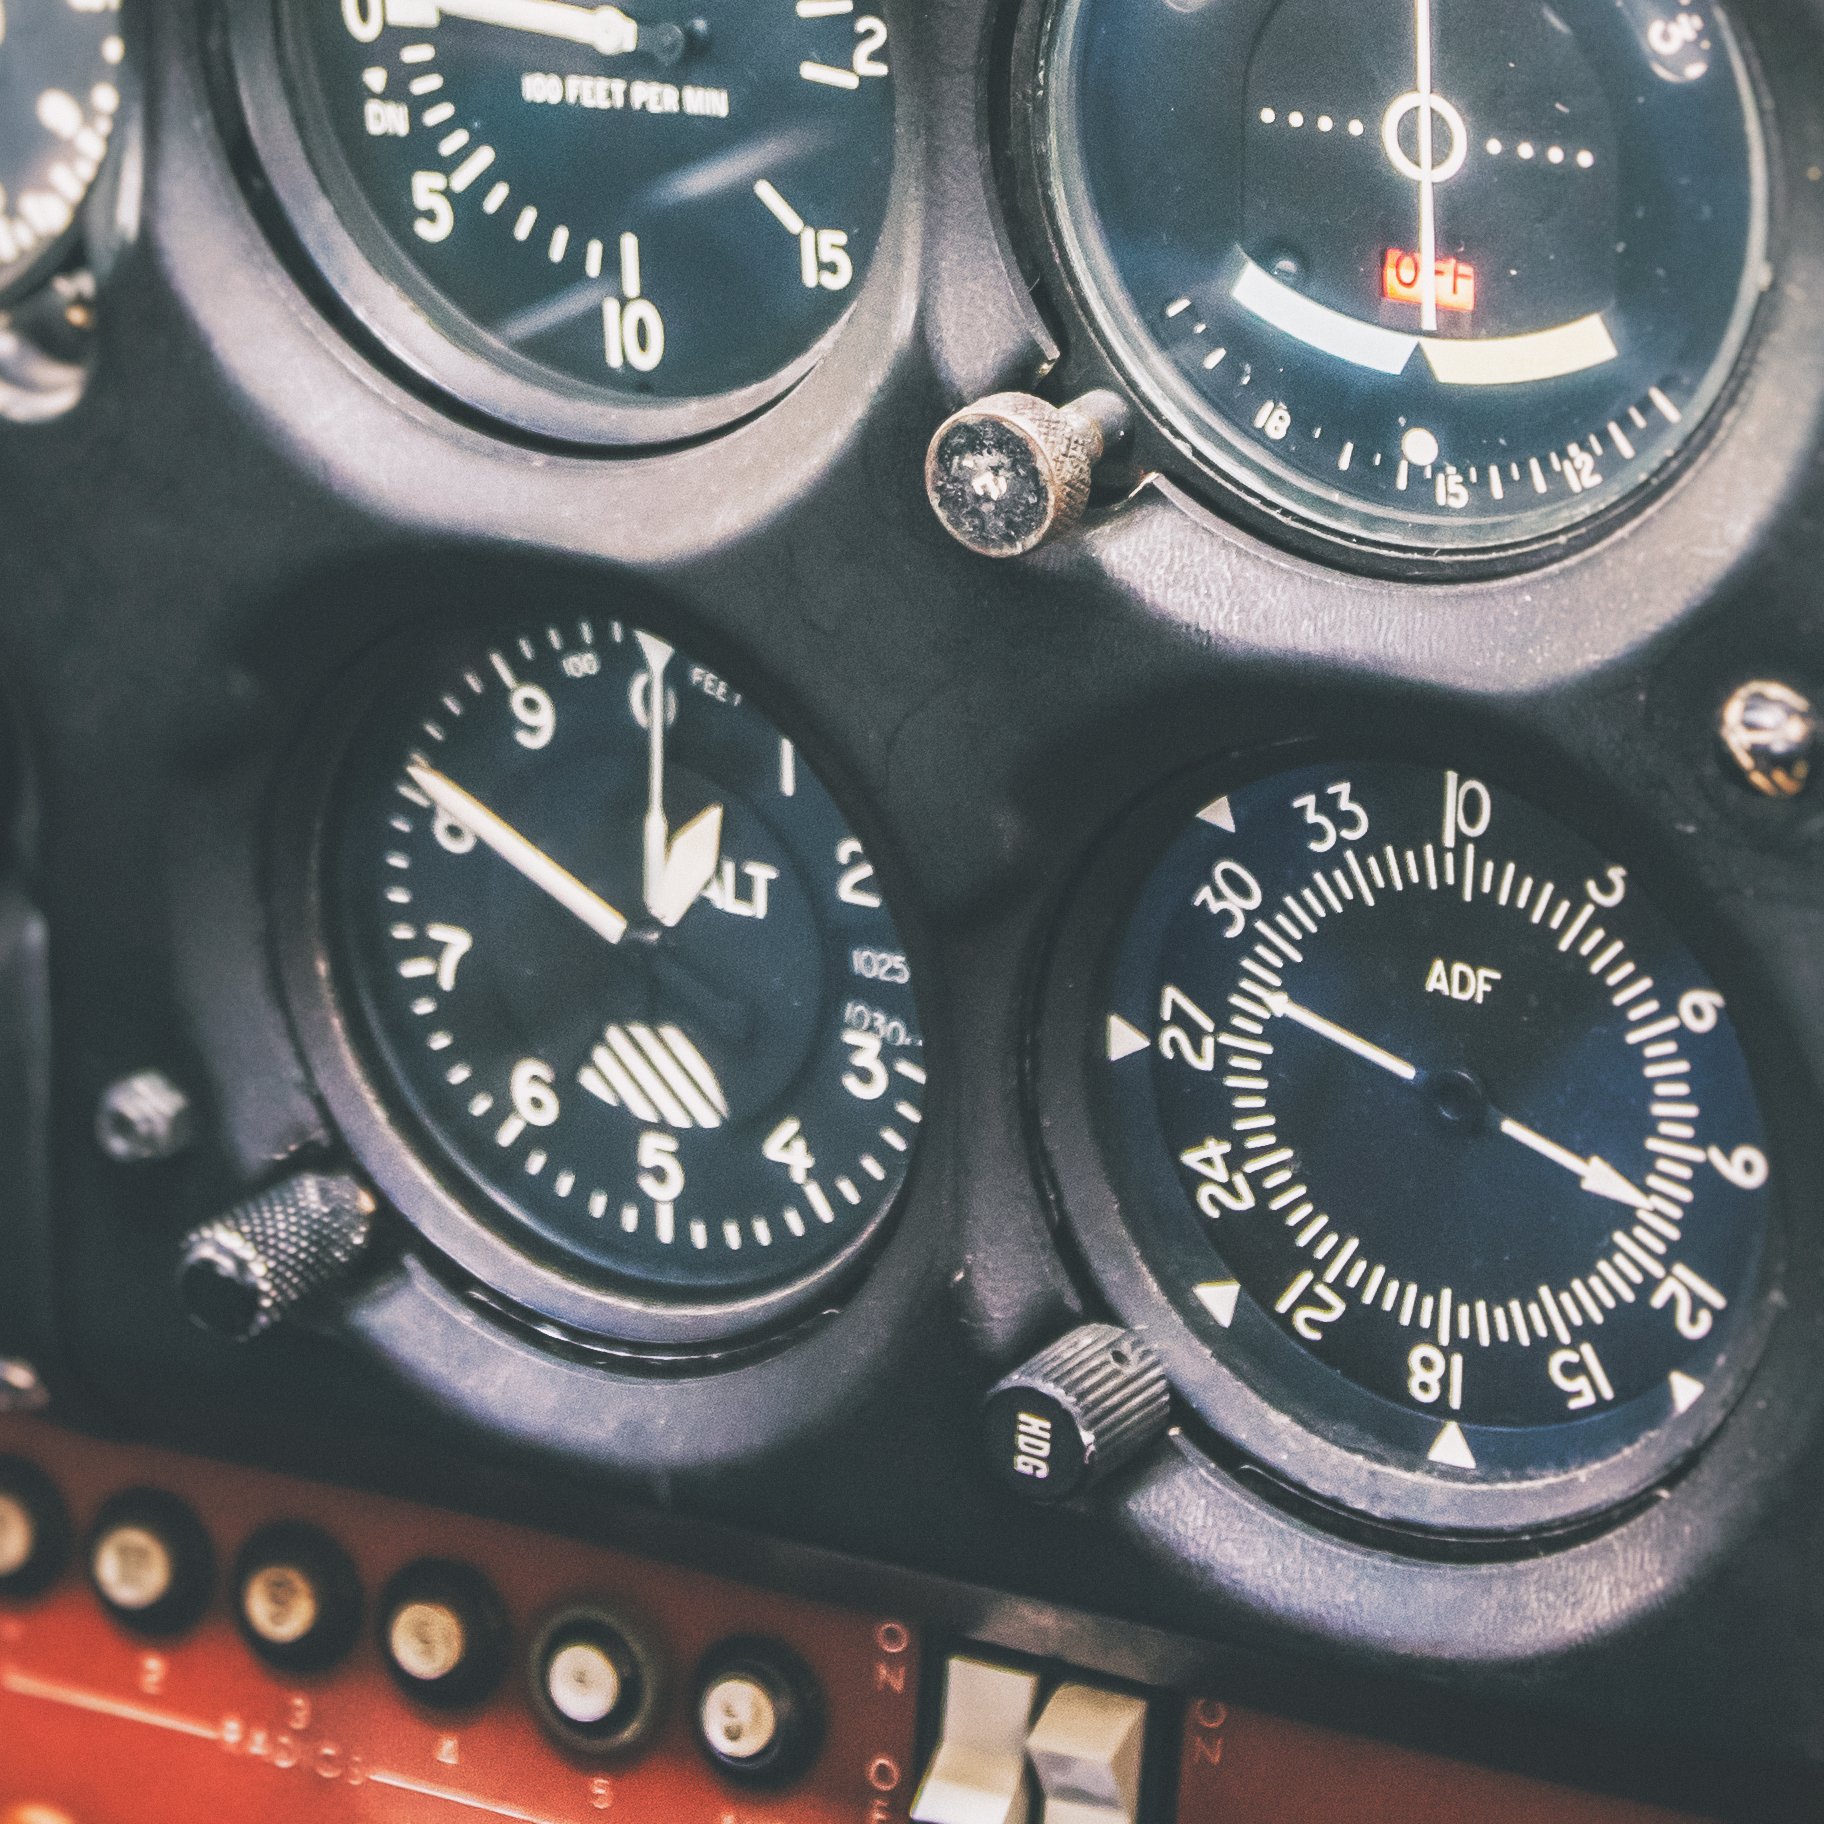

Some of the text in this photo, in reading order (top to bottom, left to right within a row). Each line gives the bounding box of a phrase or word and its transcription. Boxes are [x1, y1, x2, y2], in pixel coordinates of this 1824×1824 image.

[364, 97, 409, 137] DN
[521, 72, 729, 118] 100 FEET PER MIN
[412, 171, 454, 243] 5
[800, 229, 853, 290] 15
[604, 297, 664, 373] 10
[1254, 400, 1293, 441] 18
[1436, 472, 1469, 507] 15
[1566, 447, 1601, 492] 12
[510, 684, 555, 748] 9
[1292, 780, 1370, 853] 33
[835, 837, 882, 908] 2
[1193, 860, 1262, 938] 30
[426, 924, 472, 991] 7
[852, 947, 911, 985] 1025
[1425, 959, 1502, 1005] ADF
[1159, 985, 1217, 1073] 27
[1678, 988, 1725, 1034] 6
[512, 1056, 559, 1127] 6
[840, 1029, 888, 1100] 3
[637, 1130, 685, 1203] 5
[762, 1117, 815, 1183] 4
[1180, 1135, 1256, 1219] 24
[1706, 1144, 1769, 1190] 9
[1276, 1269, 1347, 1341] 21
[1650, 1262, 1727, 1340] 12
[1406, 1344, 1463, 1409] 18
[1548, 1343, 1615, 1409] 15
[1014, 1412, 1052, 1479] HDG
